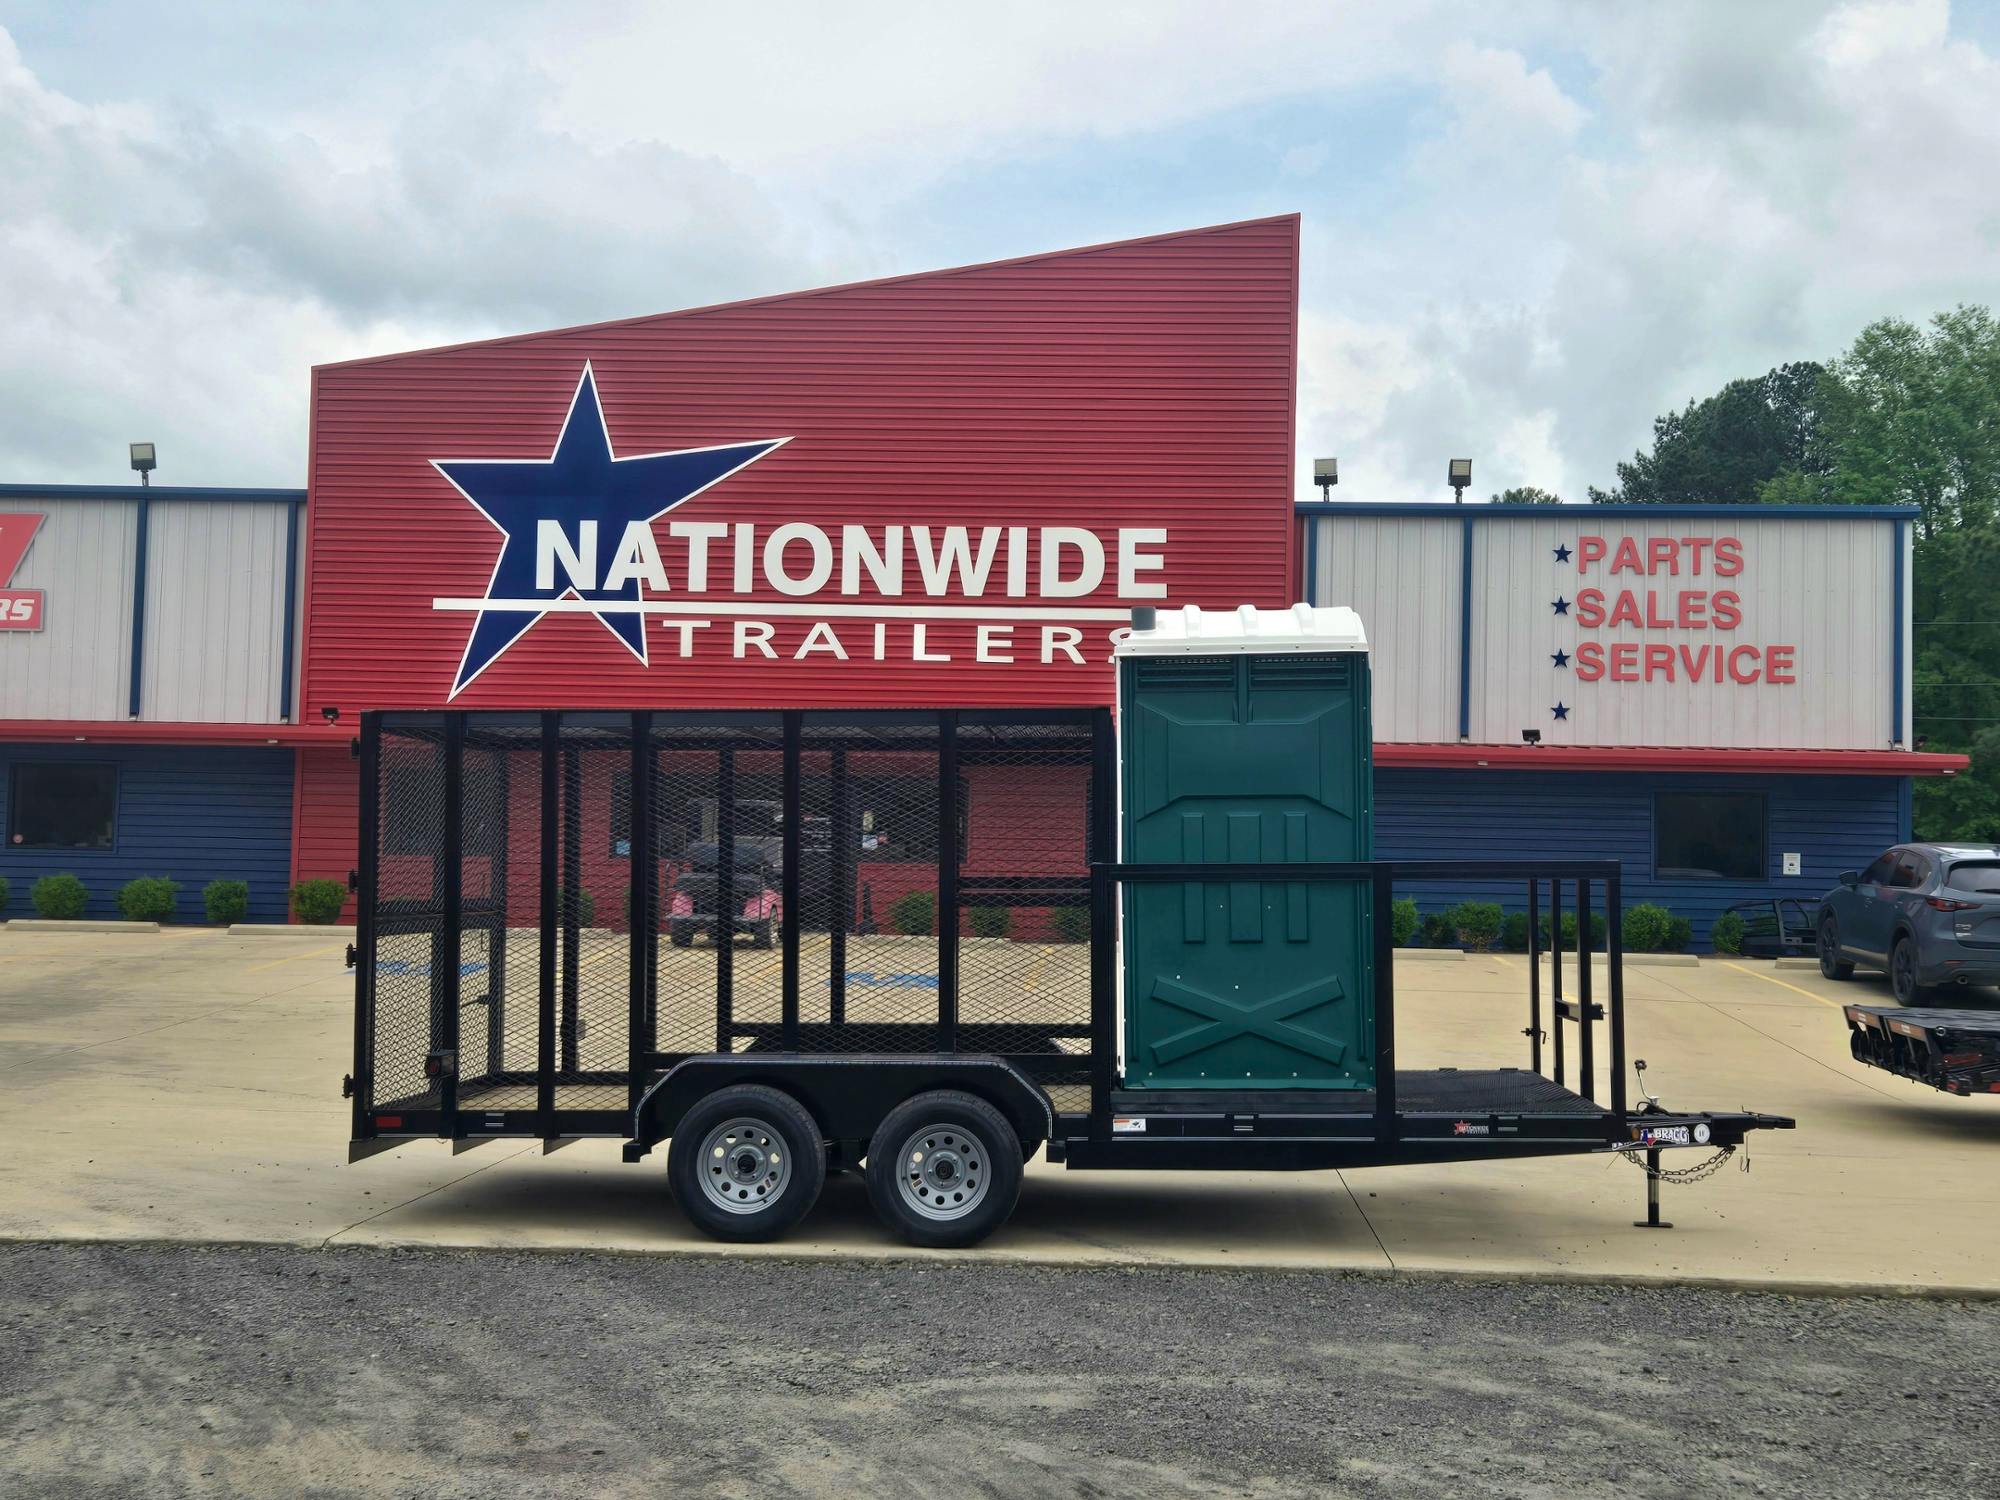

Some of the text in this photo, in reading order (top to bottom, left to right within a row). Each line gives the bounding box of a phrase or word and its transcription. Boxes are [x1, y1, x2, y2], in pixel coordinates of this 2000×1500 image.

[536, 519, 1168, 599] NATIONWIDE
[1578, 536, 1744, 577] PARTS
[1576, 588, 1742, 630] SALES
[1575, 642, 1796, 684] SERVICE
[1654, 1127, 1689, 1144] BRAGG
